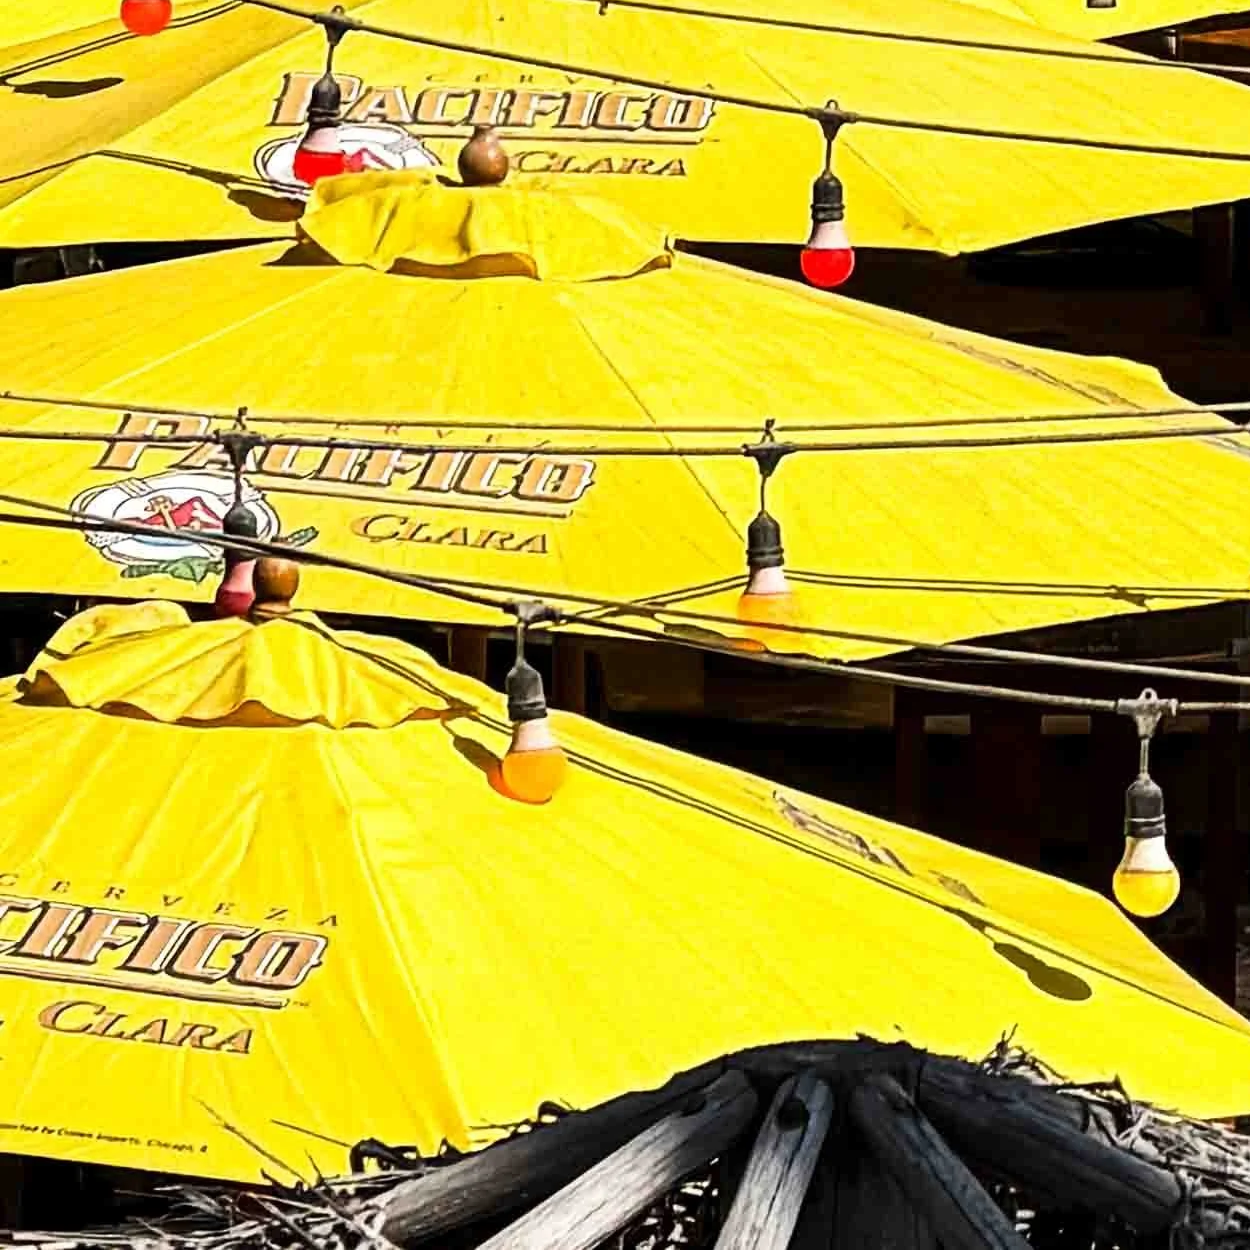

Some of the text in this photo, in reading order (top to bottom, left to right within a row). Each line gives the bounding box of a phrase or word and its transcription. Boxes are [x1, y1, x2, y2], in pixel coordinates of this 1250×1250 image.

[265, 73, 716, 132] PACIFICO
[509, 150, 687, 176] CLARA
[92, 413, 595, 502] PACIFICO
[351, 513, 549, 554] CLARA
[38, 999, 253, 1055] CLARA
